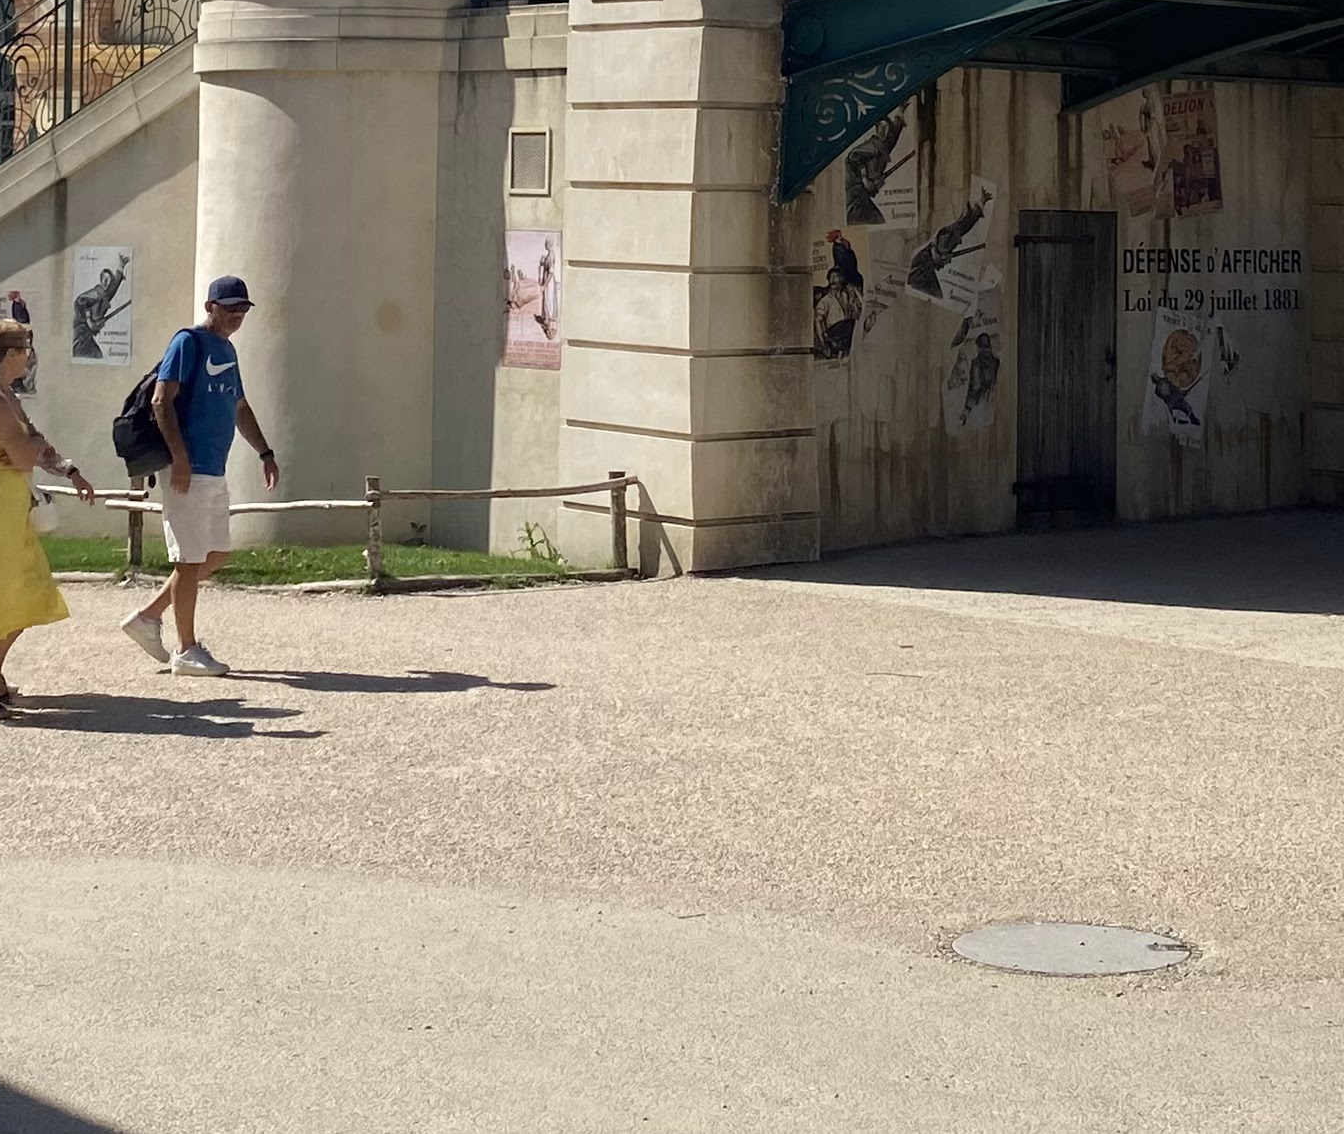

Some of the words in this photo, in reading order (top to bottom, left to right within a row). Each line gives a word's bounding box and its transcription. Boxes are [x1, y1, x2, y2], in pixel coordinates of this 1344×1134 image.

[1123, 242, 1201, 274] DÉFENSE
[1123, 289, 1152, 312] Loi
[1158, 289, 1179, 310] du
[1184, 289, 1204, 310] 29
[1208, 288, 1258, 318] juillet
[1263, 288, 1301, 310] 1881
